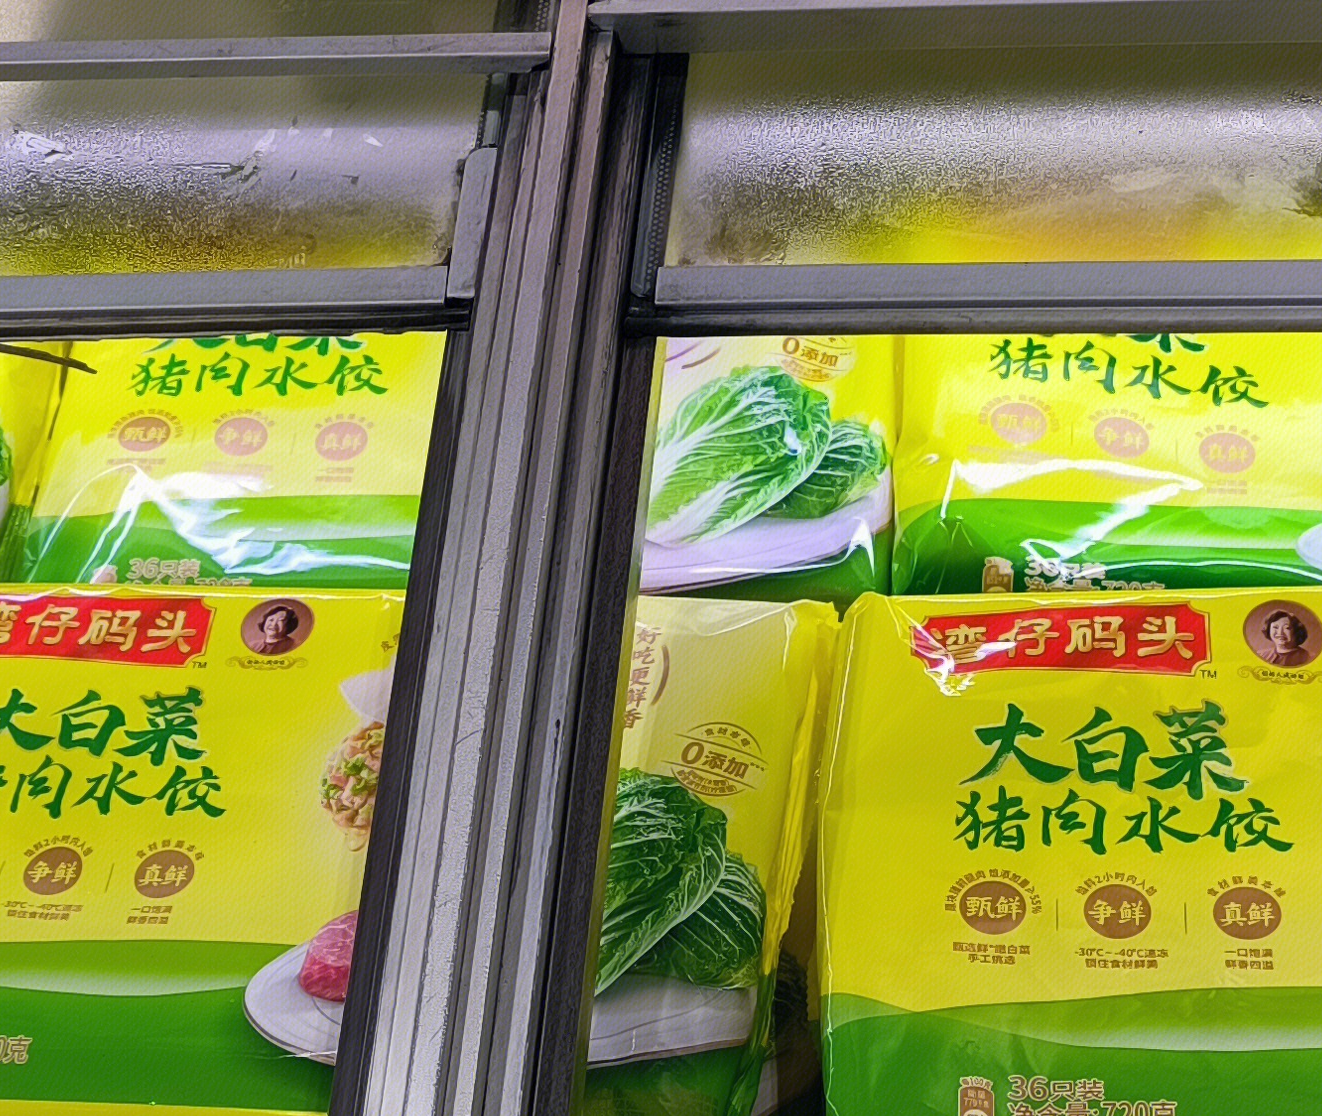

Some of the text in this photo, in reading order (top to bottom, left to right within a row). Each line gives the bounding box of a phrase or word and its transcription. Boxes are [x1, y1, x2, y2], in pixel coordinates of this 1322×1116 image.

[127, 351, 389, 397] 猪肉水饺
[988, 337, 1270, 409] 猪肉水饺
[931, 616, 1218, 680] 湾仔码头 TM
[681, 741, 751, 780] 0添加
[958, 700, 1249, 801] 大白菜
[952, 785, 1296, 856] 猪肉水饺
[27, 861, 79, 885] 争鲜
[138, 864, 190, 887] 真鲜
[965, 894, 1023, 923] 甄鲜
[1087, 898, 1147, 927] 争鲜
[1220, 899, 1276, 929] 真鲜
[1007, 1074, 1105, 1102] 36只装
